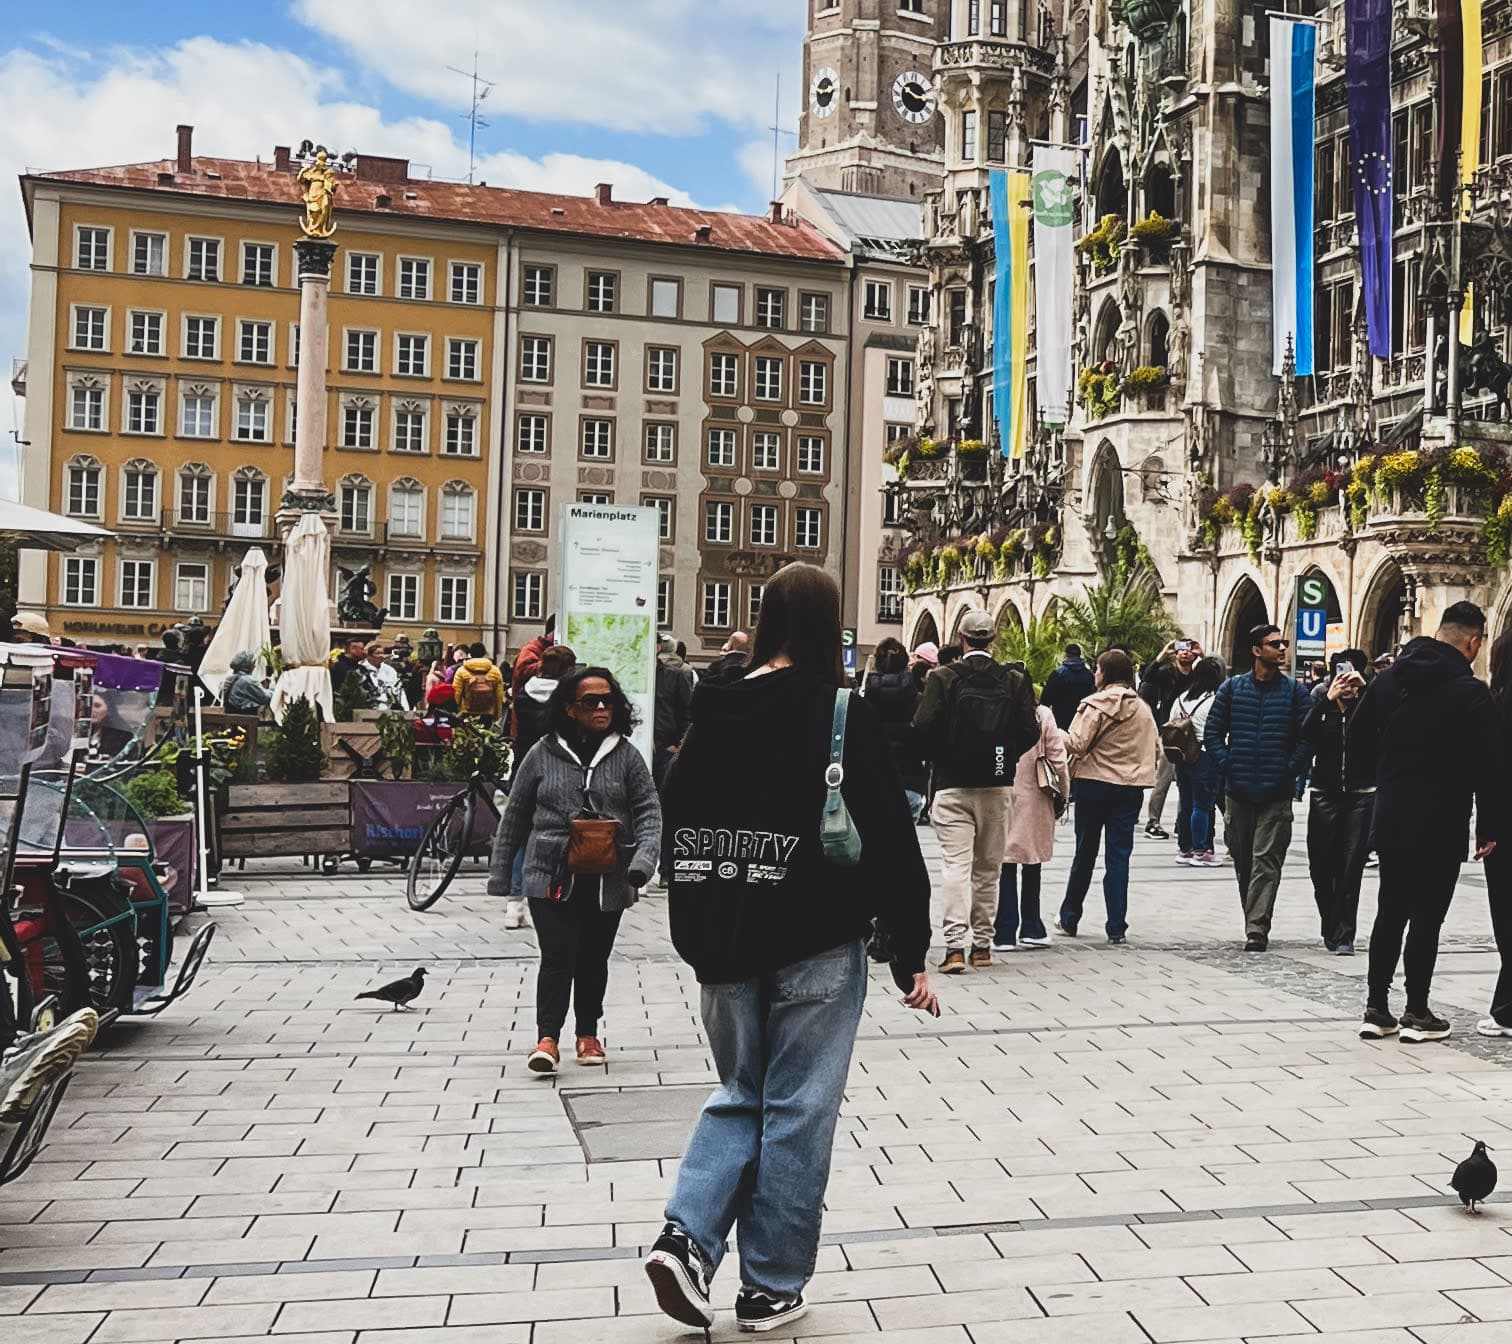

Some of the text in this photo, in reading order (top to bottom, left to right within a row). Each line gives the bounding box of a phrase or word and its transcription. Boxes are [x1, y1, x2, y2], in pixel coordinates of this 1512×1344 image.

[570, 508, 637, 522] Marienplatz
[1303, 579, 1322, 605] S
[1302, 612, 1321, 637] U
[842, 629, 854, 646] S
[673, 827, 800, 863] SPORTY
